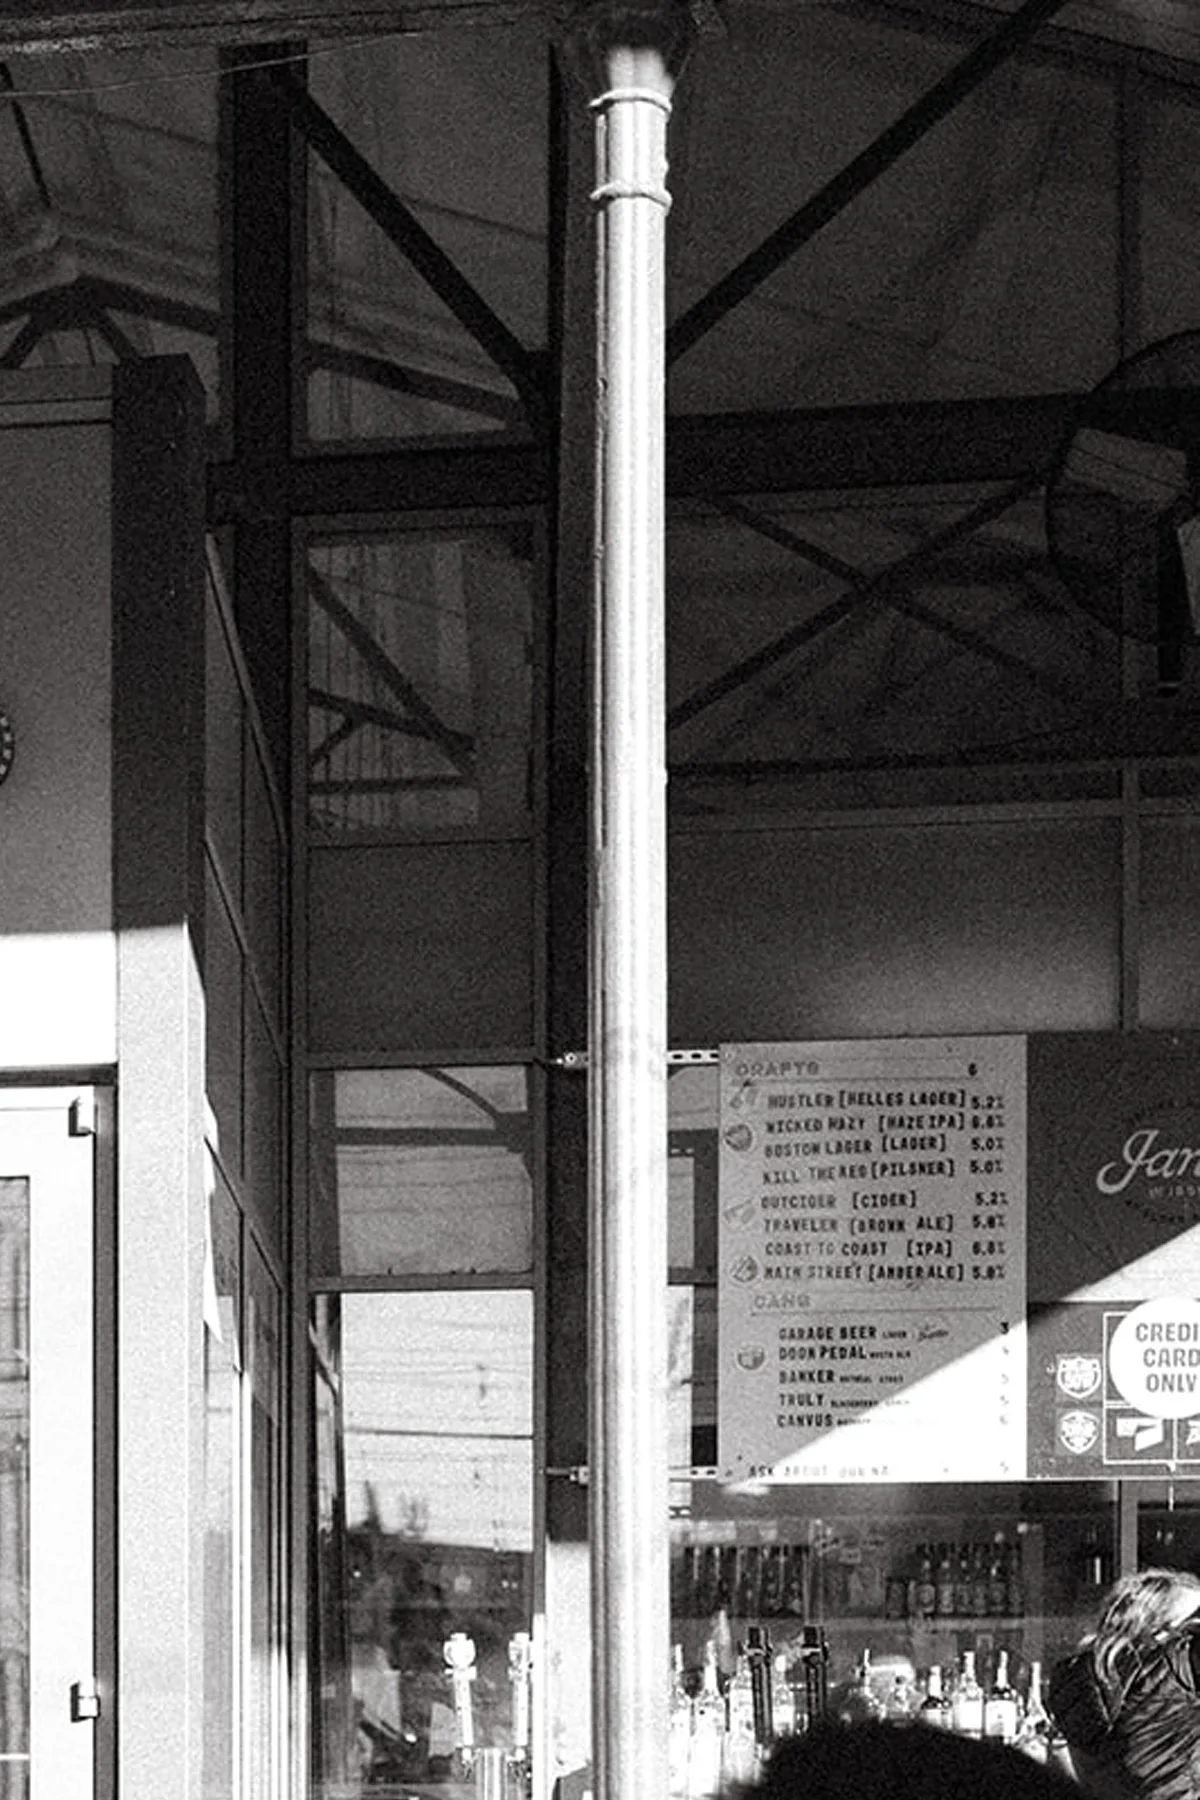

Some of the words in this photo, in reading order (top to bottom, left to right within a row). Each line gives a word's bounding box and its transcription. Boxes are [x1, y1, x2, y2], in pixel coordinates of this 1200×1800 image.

[767, 1093, 834, 1109] HUSTLER
[764, 1143, 820, 1159] BOSTON
[825, 1140, 872, 1155] LAGER
[841, 1241, 887, 1256] COAST
[808, 1265, 862, 1280] STREET
[840, 1325, 876, 1340] BEER
[1145, 1373, 1197, 1393] ONLY
[779, 1393, 824, 1408] TRULY
